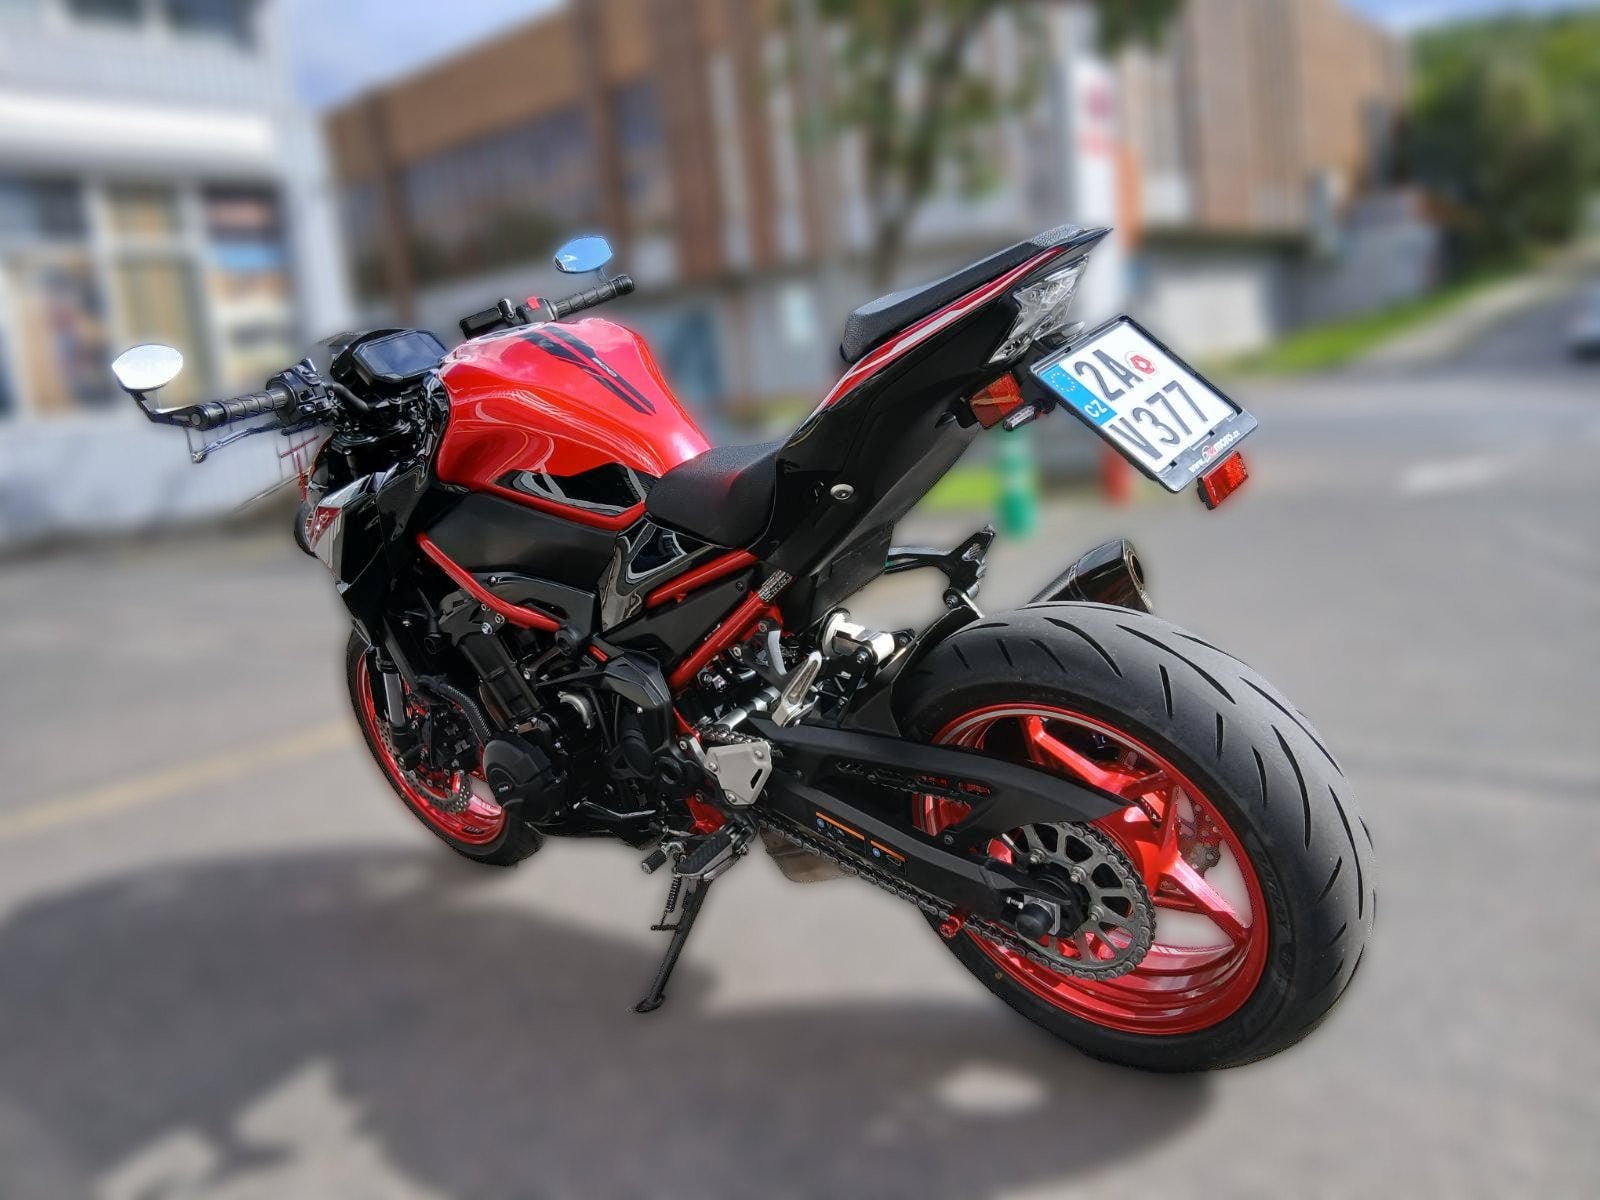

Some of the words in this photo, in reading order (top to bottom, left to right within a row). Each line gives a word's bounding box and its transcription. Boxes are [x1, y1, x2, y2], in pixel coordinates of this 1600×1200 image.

[1074, 349, 1143, 401] 2A
[1084, 400, 1107, 418] CZ
[1108, 380, 1208, 460] V377
